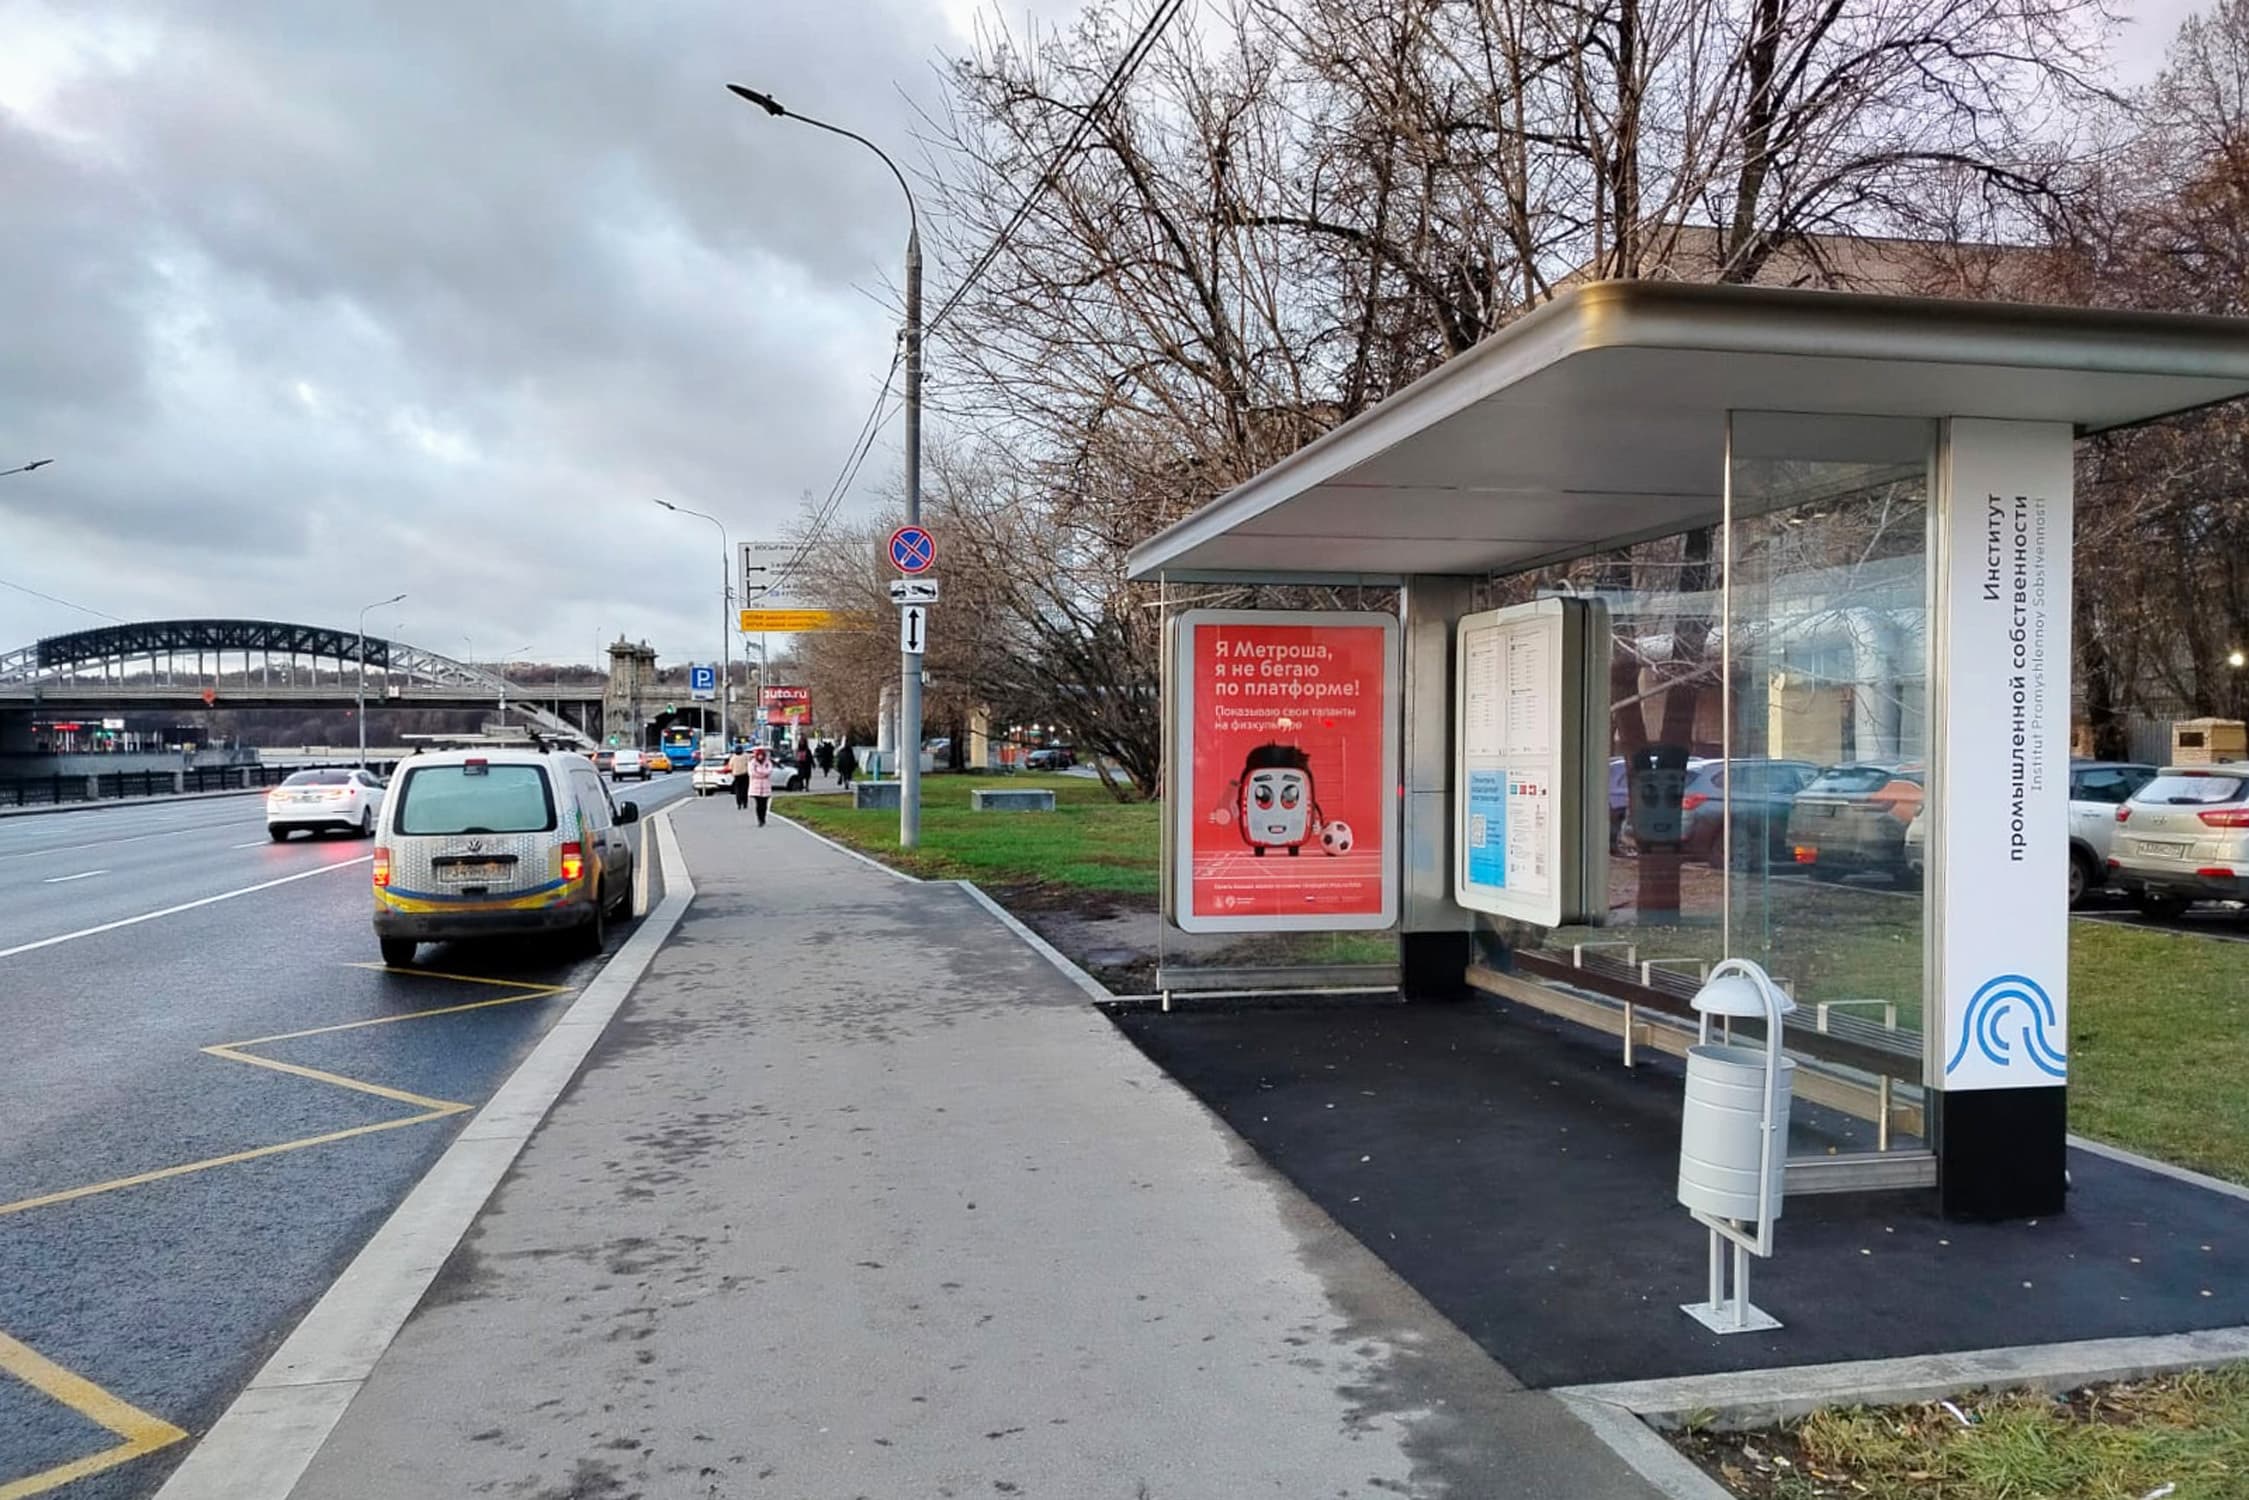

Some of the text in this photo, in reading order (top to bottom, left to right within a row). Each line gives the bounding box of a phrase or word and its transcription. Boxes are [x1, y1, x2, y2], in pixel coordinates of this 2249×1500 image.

[1983, 493, 2005, 600] Институт
[2033, 498, 2046, 607] Sobstvennosti
[1216, 641, 1332, 661] Я Метроша,
[1216, 659, 1319, 677] я не бегаю
[1216, 679, 1360, 699] по платформе!
[2008, 496, 2027, 861] промышленной собственности
[1215, 705, 1280, 717] Показываю
[1282, 708, 1309, 717] свои
[2031, 735, 2043, 791] Institut
